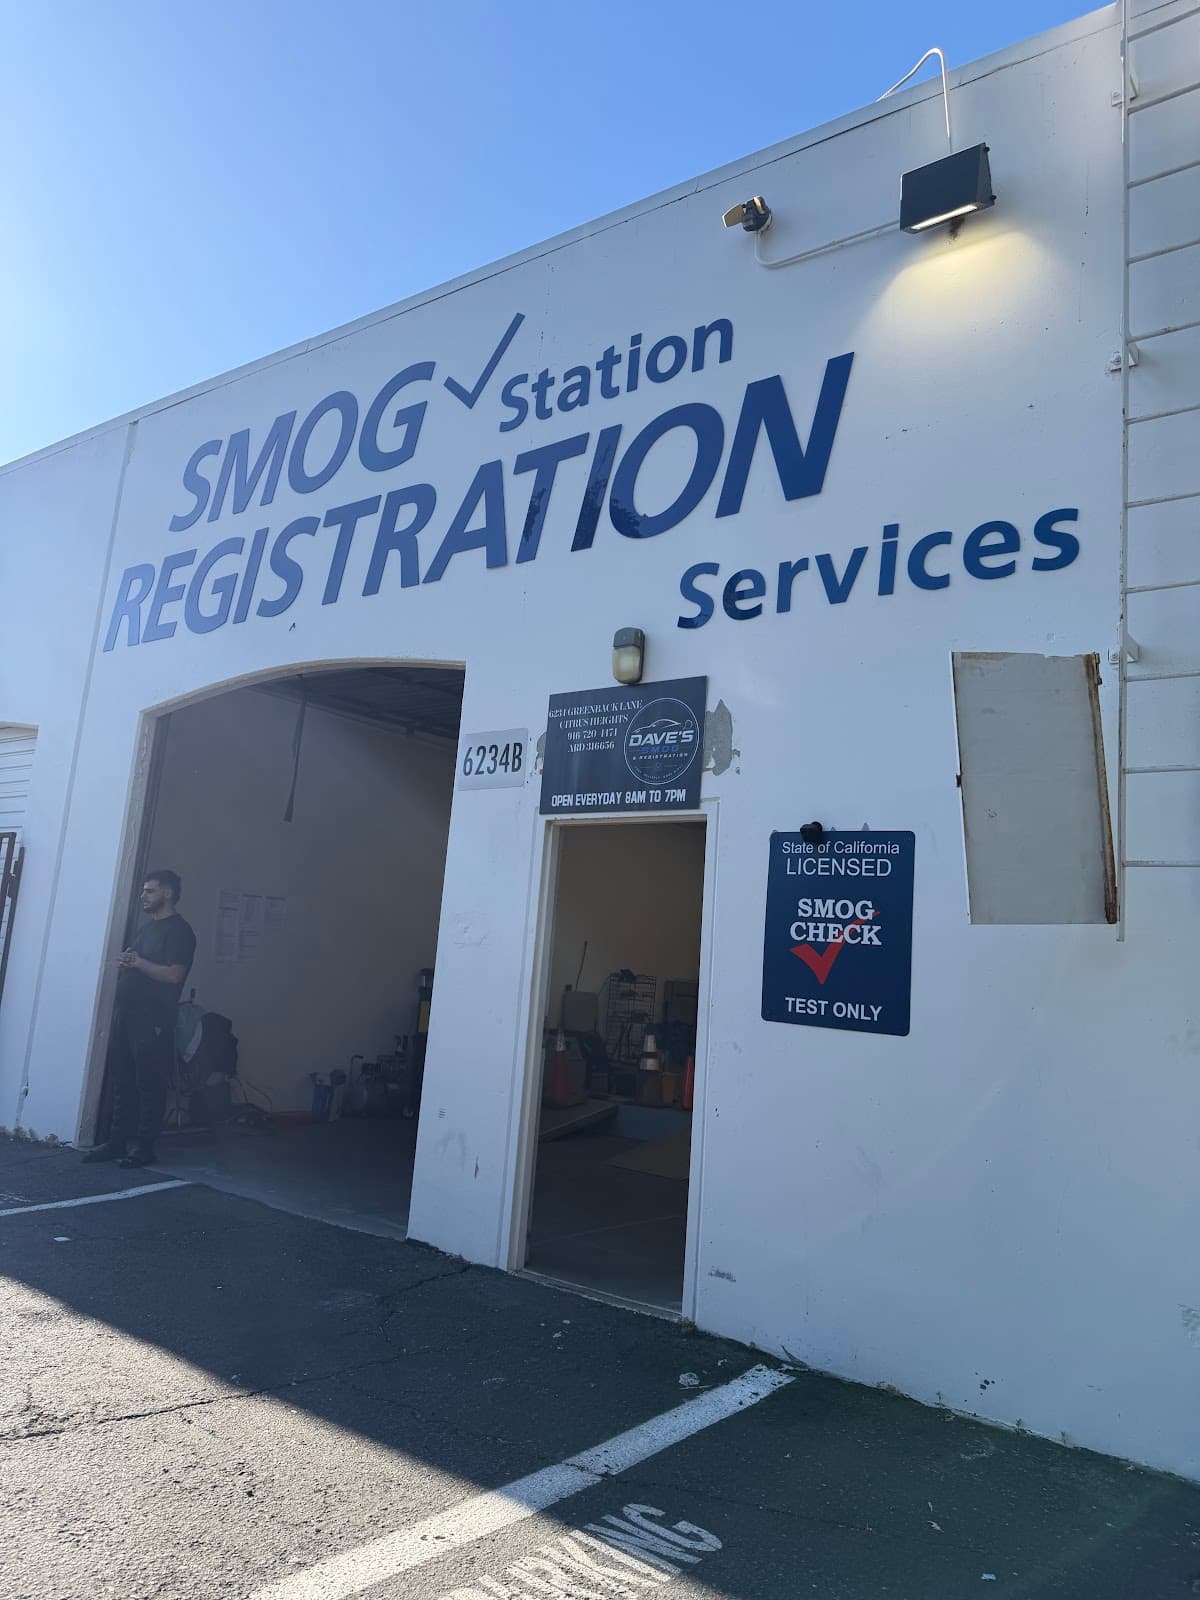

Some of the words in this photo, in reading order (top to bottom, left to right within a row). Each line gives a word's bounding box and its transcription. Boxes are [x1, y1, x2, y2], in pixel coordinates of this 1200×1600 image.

[169, 361, 436, 532] SMOG
[500, 318, 734, 432] Station
[103, 352, 855, 652] REGISTRATION
[677, 508, 1080, 629] Services
[567, 702, 619, 716] GREENBACK
[620, 699, 643, 711] LANE
[559, 718, 589, 729] CITRUS
[589, 714, 629, 726] HEIGHTS
[629, 730, 695, 747] DAVE'S
[463, 742, 523, 776] 6234B
[551, 794, 574, 807] OPEN
[575, 791, 623, 806] EVERYDAY
[625, 790, 646, 804] 8AM
[648, 790, 661, 803] TO
[664, 788, 687, 802] 7PM
[782, 841, 813, 854] State
[818, 840, 831, 854] of
[834, 840, 900, 855] California
[786, 858, 892, 877] LICENSED
[797, 898, 875, 920] SMOG
[790, 921, 882, 946] CHECK
[785, 997, 828, 1016] TEST
[833, 1002, 882, 1022] ONLY
